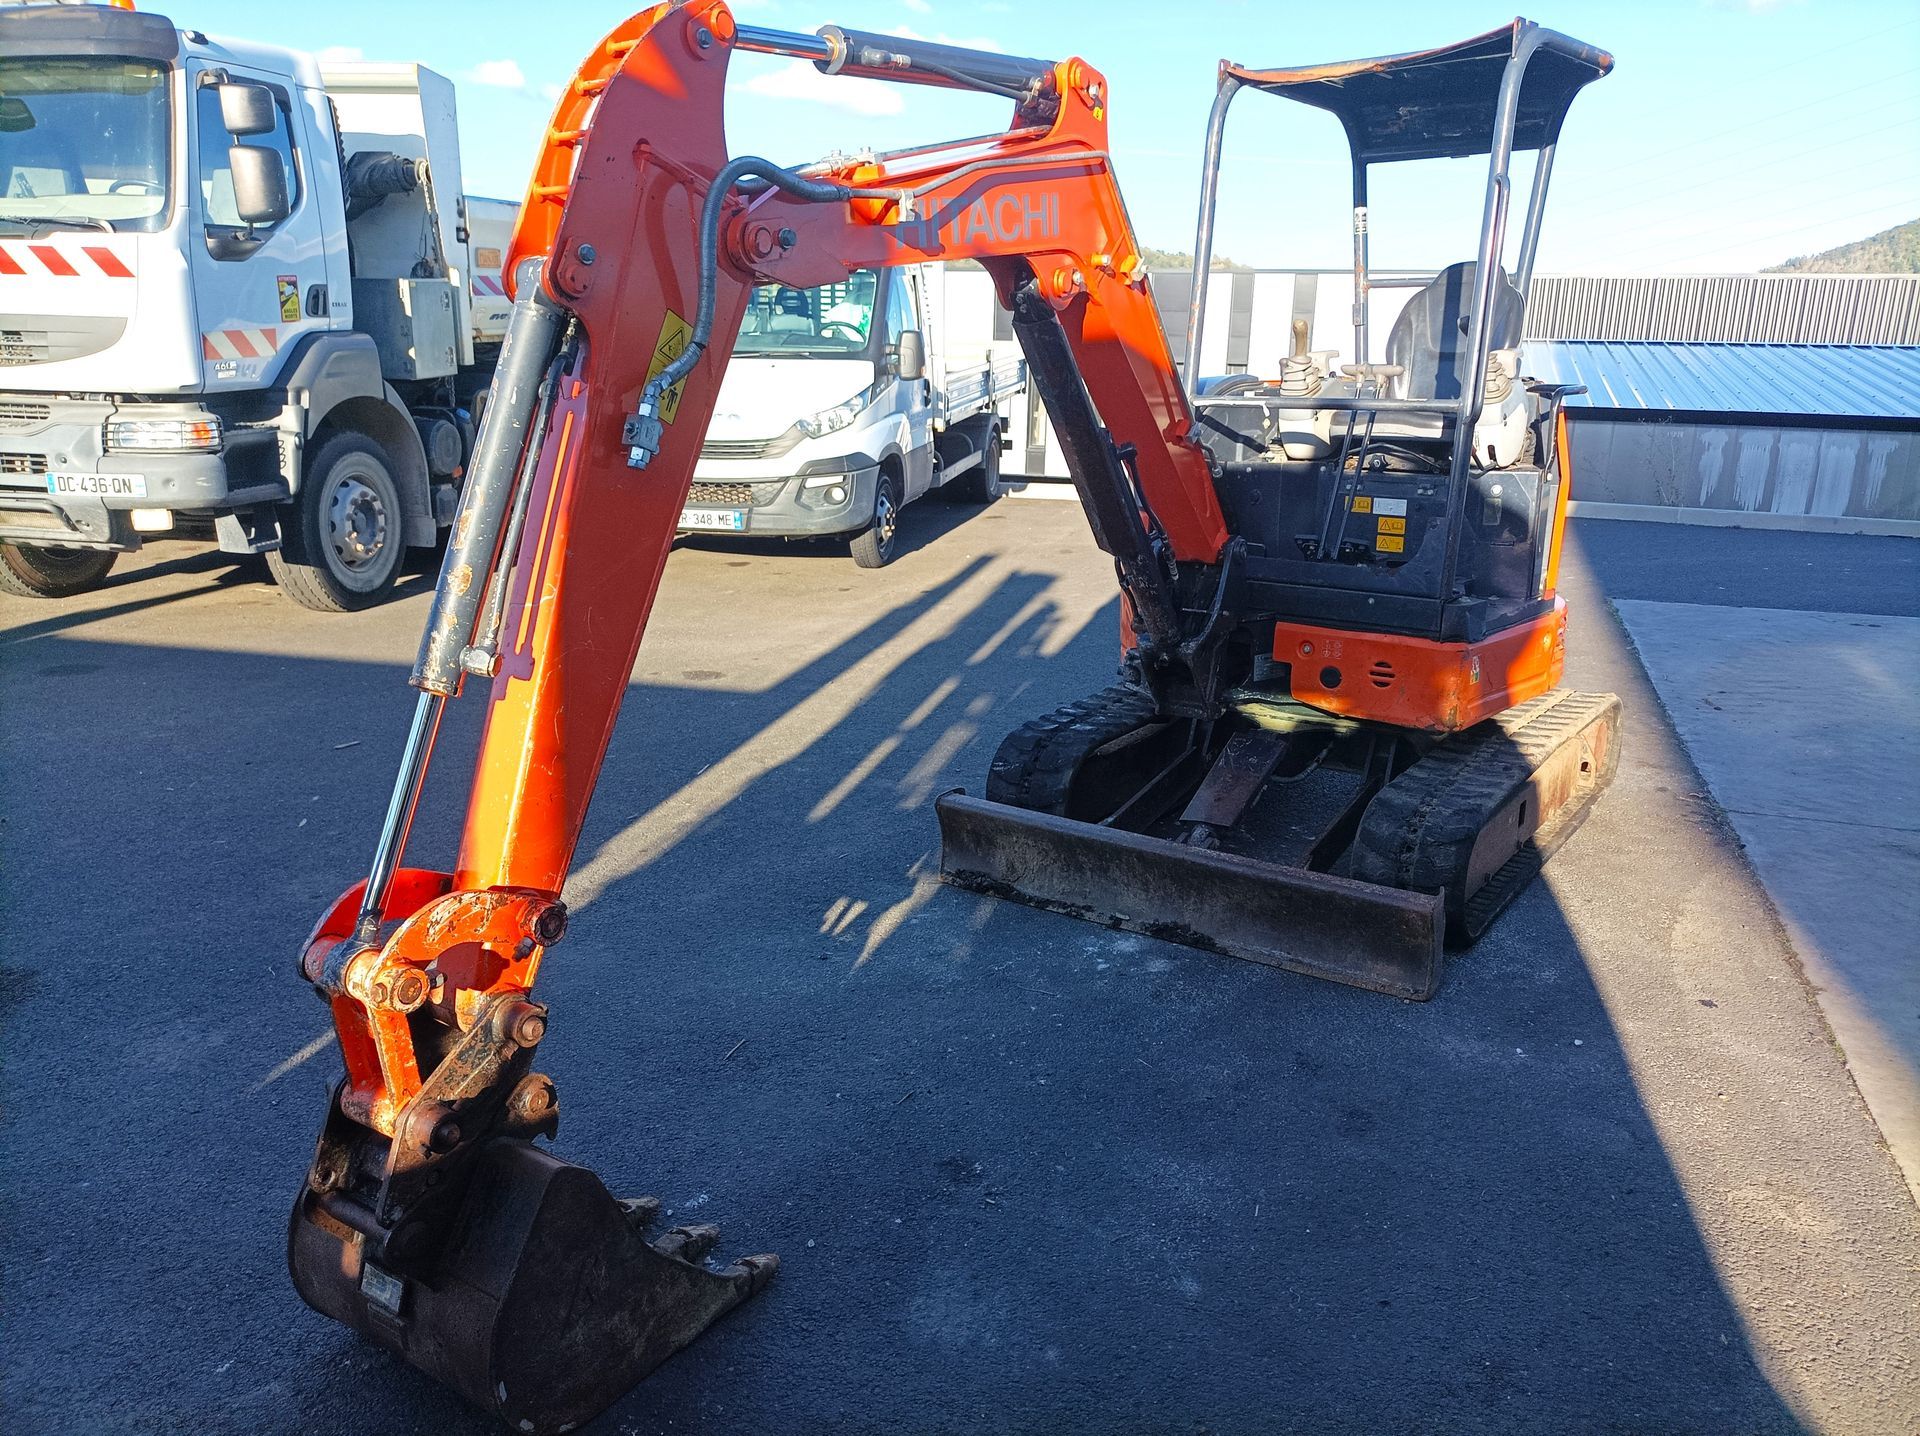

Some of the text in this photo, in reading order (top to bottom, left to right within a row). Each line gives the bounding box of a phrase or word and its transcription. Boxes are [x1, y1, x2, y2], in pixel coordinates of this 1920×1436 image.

[896, 193, 1059, 248] HITACHI
[57, 476, 132, 494] DC-436-QN
[679, 512, 732, 526] R-348-ME
